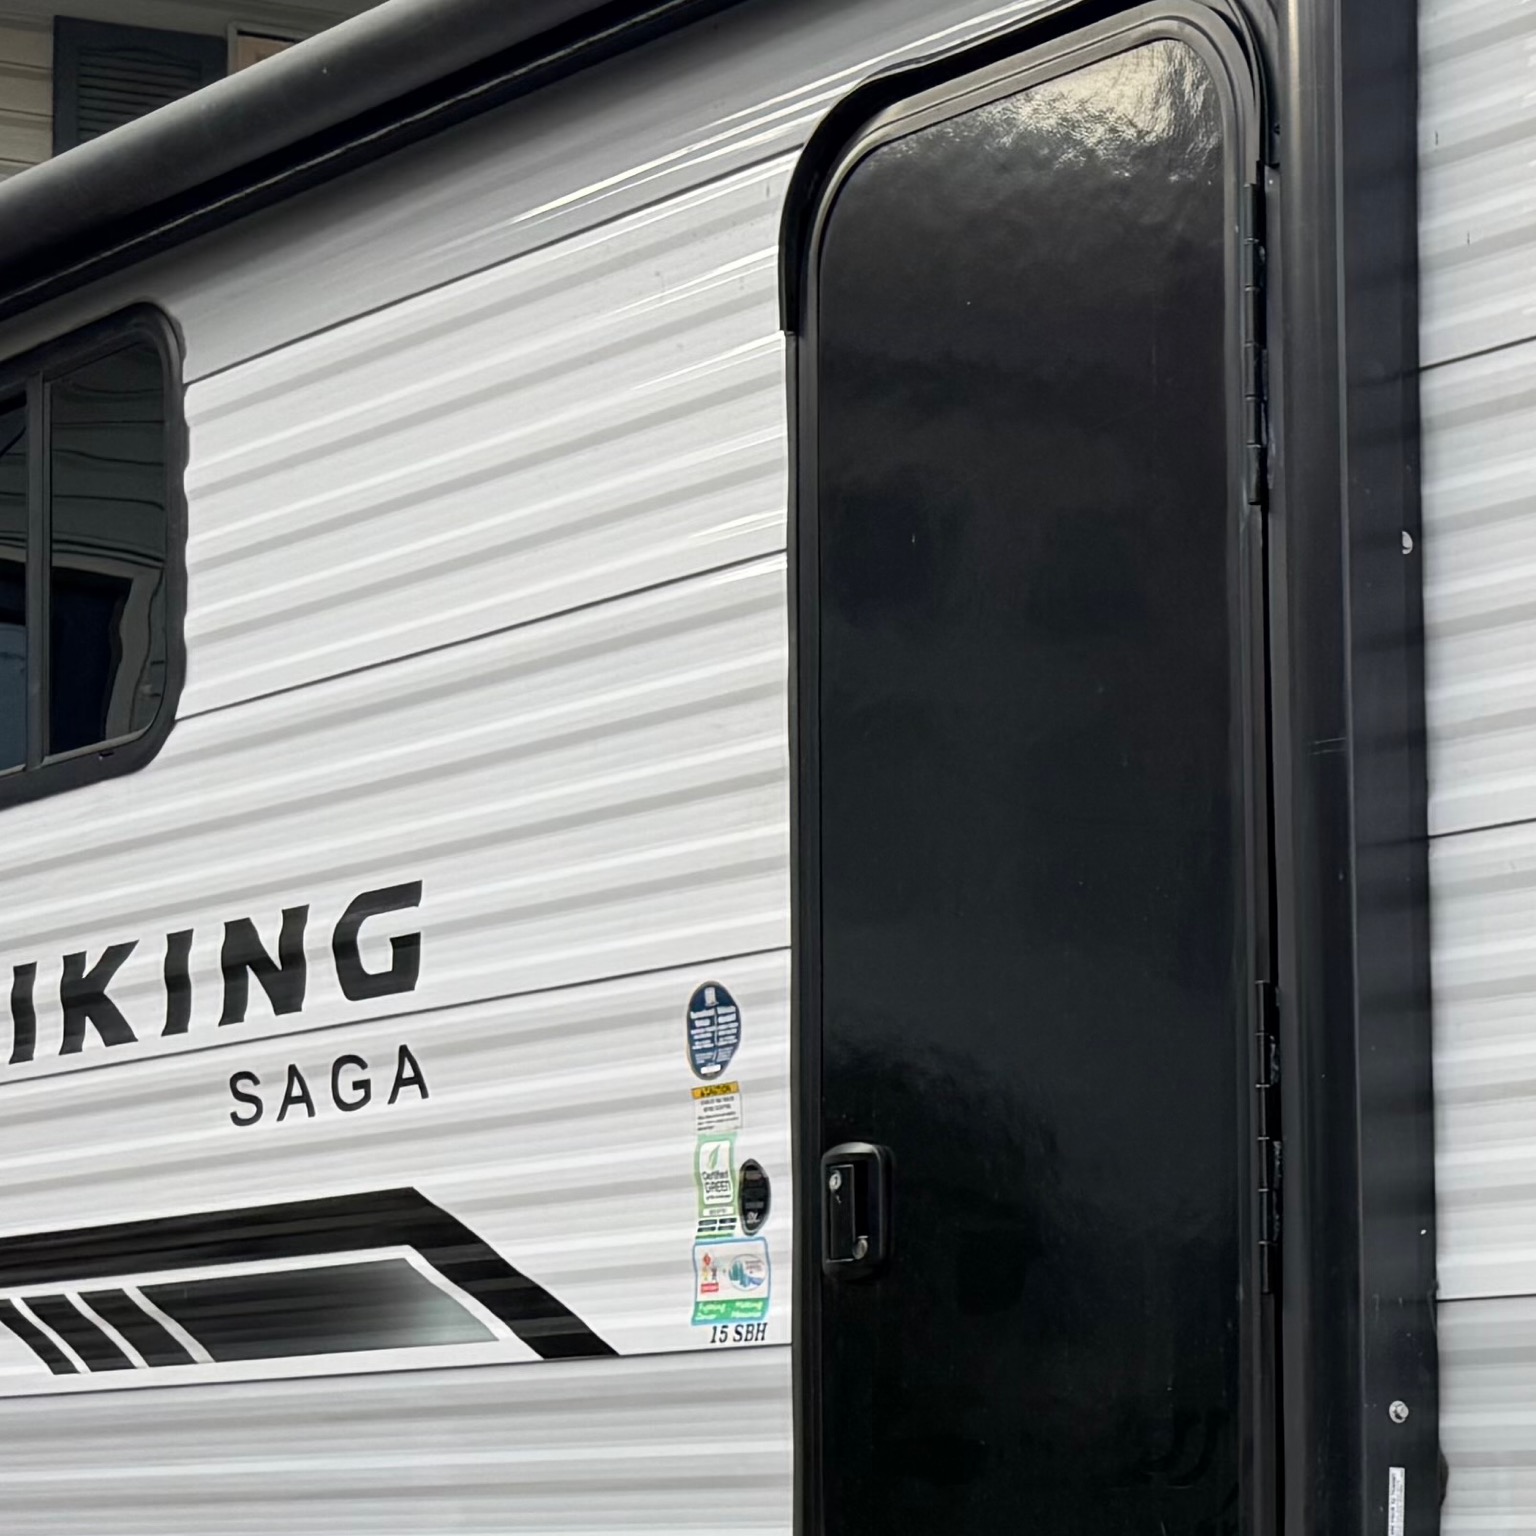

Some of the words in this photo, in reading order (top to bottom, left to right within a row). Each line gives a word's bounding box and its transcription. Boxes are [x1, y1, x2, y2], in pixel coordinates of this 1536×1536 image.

[228, 1043, 430, 1127] SAGA
[710, 1324, 729, 1344] 15
[732, 1322, 768, 1343] SBH
